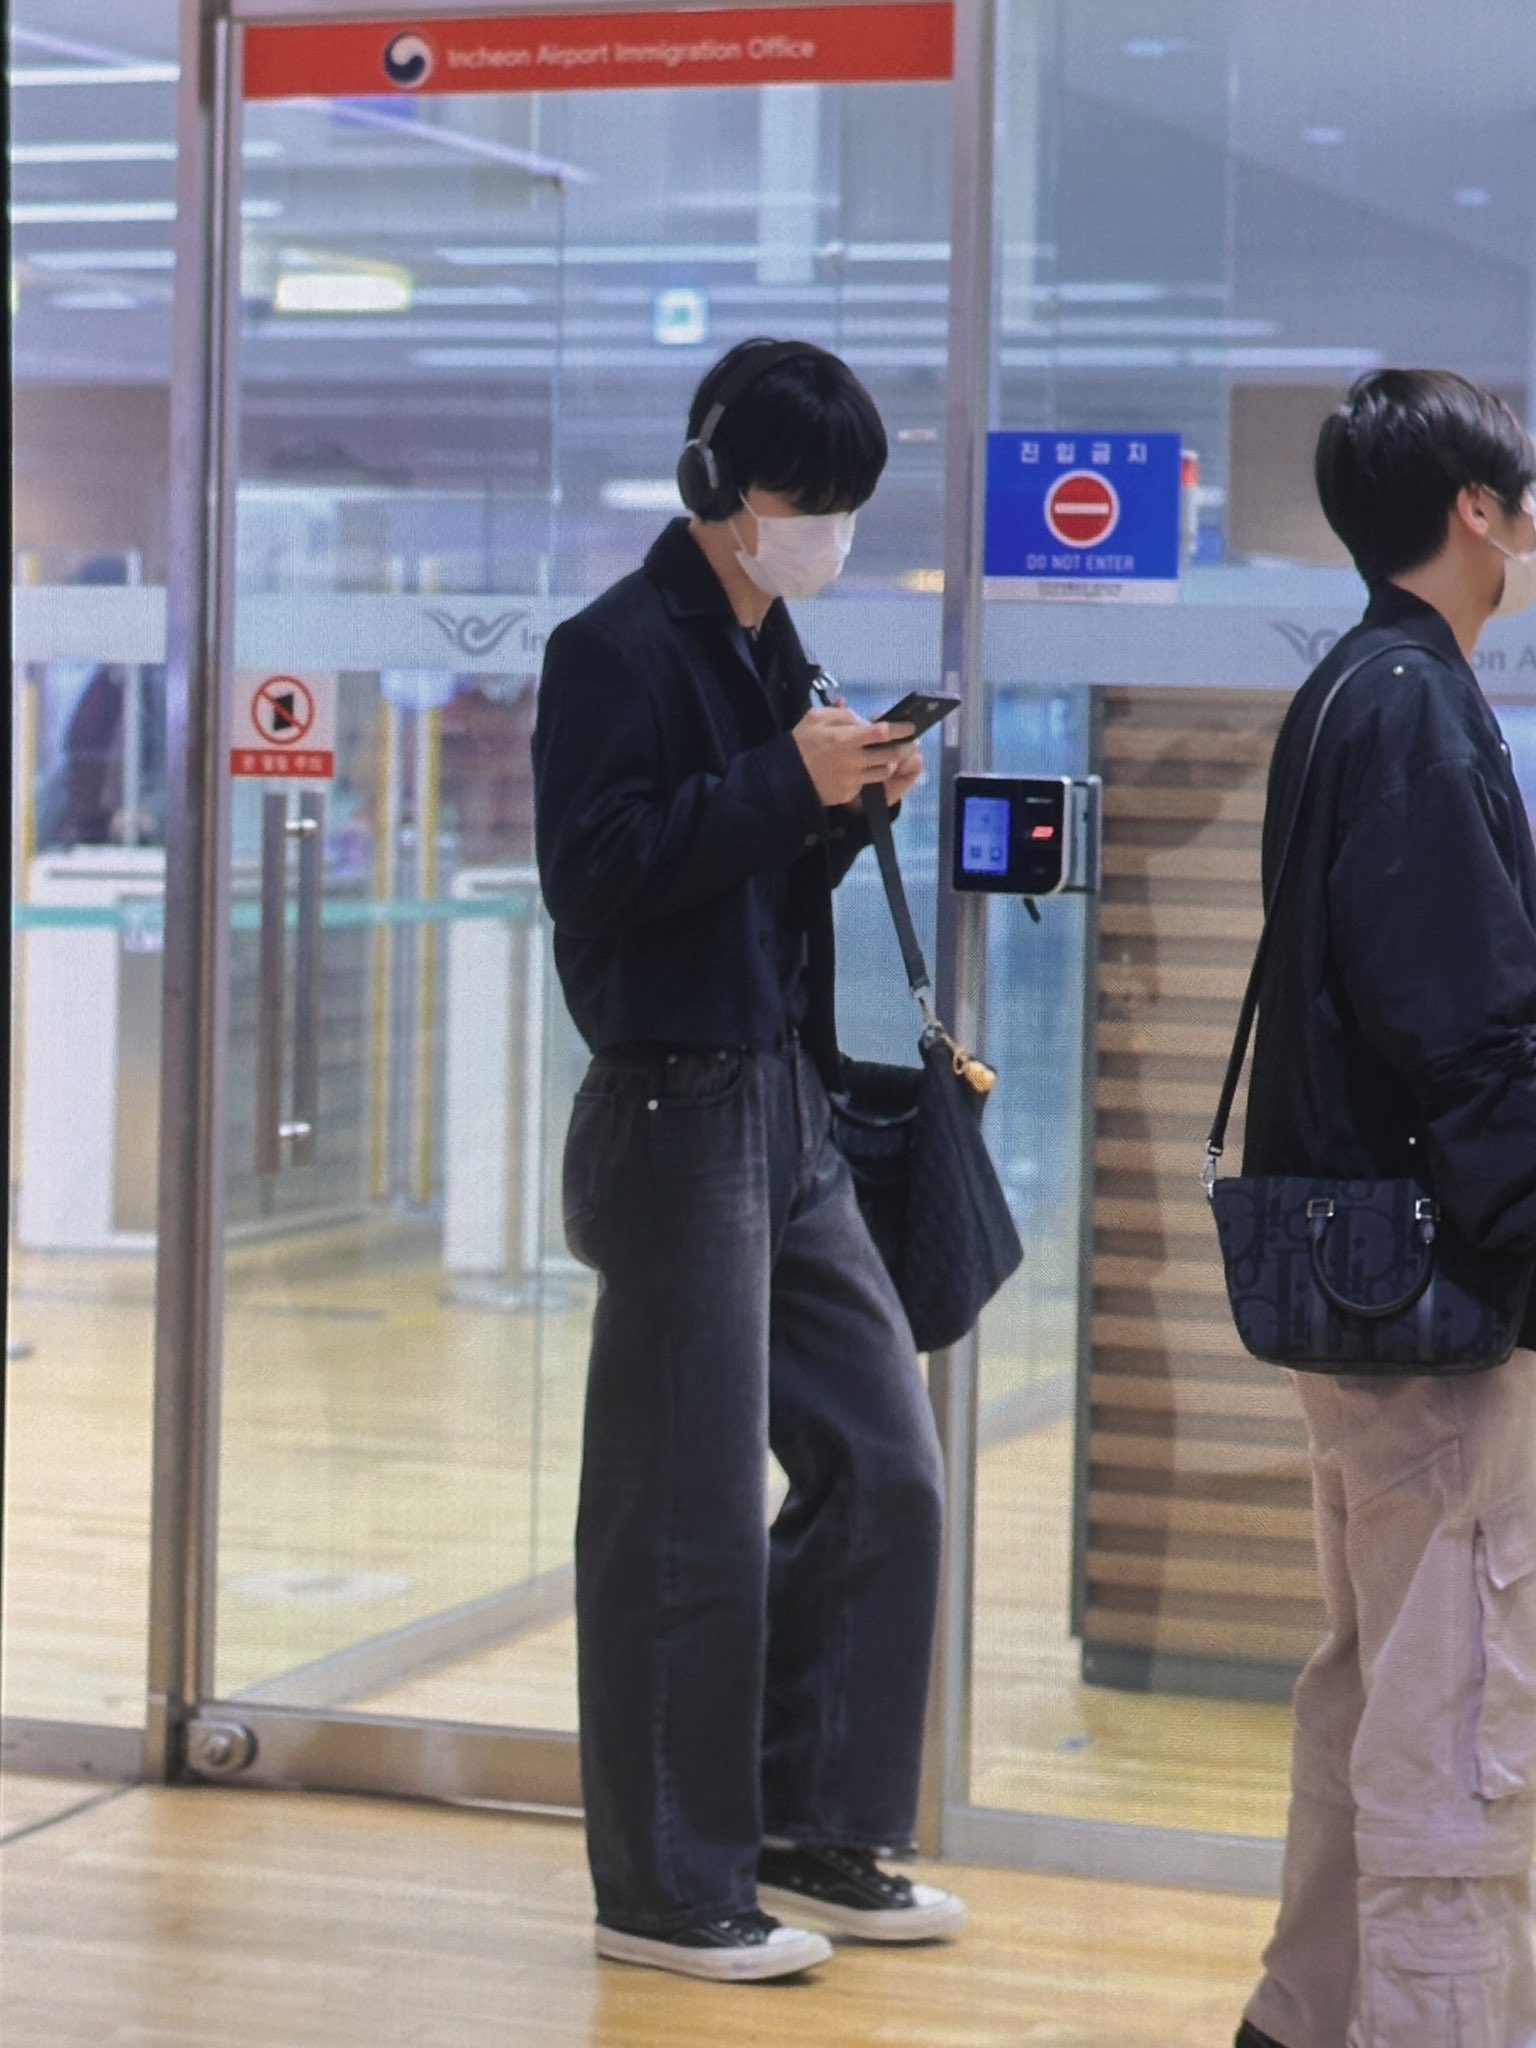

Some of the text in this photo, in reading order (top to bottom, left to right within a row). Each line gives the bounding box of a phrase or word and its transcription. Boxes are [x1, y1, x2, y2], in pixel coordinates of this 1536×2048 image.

[448, 36, 815, 70] Incheon Airport Immigration Office
[1025, 554, 1135, 572] DO NOT ENTER
